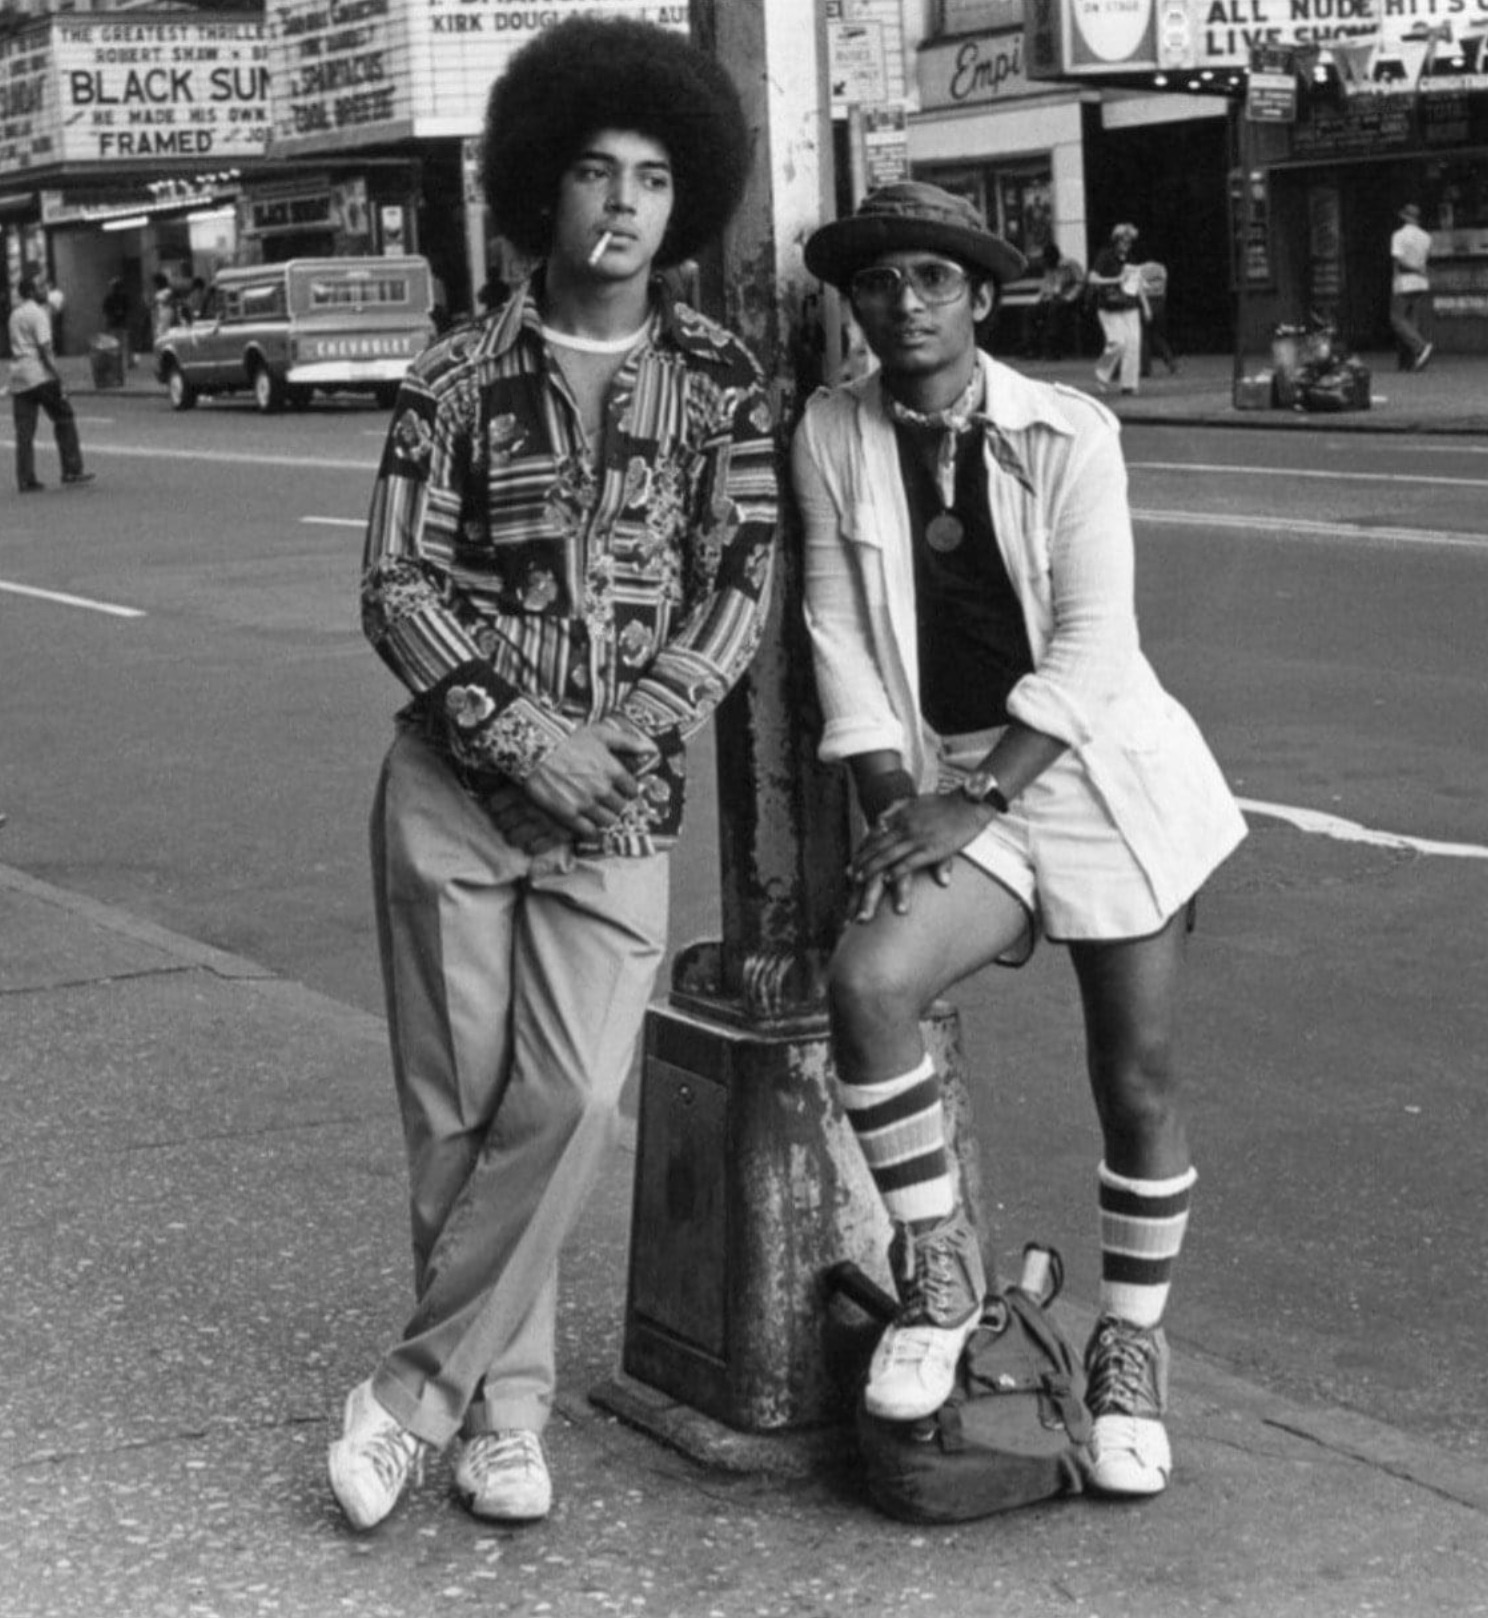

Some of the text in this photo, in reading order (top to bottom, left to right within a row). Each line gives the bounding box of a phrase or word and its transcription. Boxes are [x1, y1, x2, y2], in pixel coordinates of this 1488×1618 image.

[1206, 0, 1374, 24] ALL NUDE
[431, 13, 482, 32] KIRK
[61, 26, 92, 42] THE
[101, 25, 189, 42] GREATEST
[95, 47, 162, 63] ROBERT
[172, 47, 218, 61] SHAW
[92, 107, 266, 125] HE MADE HIS OWN
[317, 339, 410, 357] CHEVROLET
